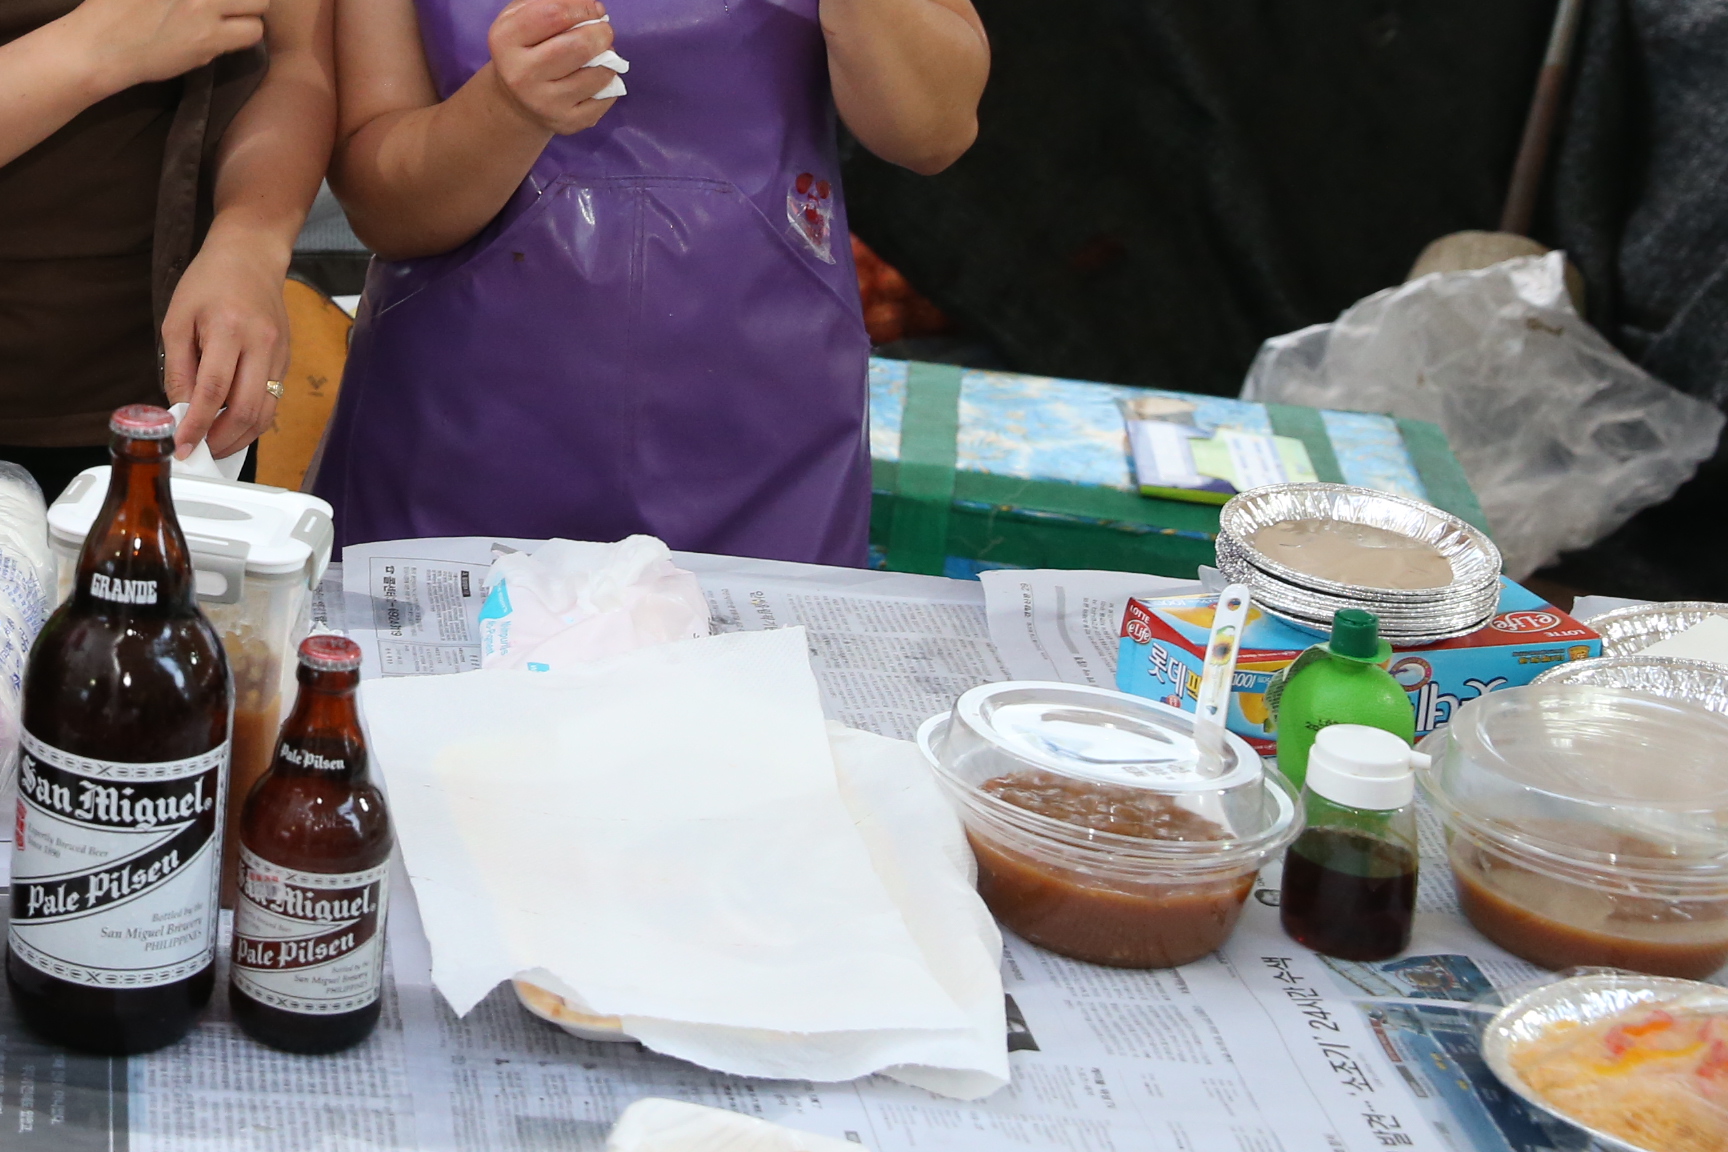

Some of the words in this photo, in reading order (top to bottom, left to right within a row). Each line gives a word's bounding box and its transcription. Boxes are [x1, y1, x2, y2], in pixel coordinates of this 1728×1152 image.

[90, 572, 158, 605] GRANDE
[1129, 604, 1151, 624] LOTTE
[1545, 628, 1586, 638] LOTTE
[280, 743, 302, 765] Pale
[302, 750, 345, 771] Pilsen
[21, 754, 73, 814] San
[74, 776, 206, 830] Miguel
[87, 845, 110, 858] Beer
[28, 884, 80, 917] Pale
[85, 849, 180, 908] Pilsen
[151, 909, 182, 923] Bottled
[183, 907, 192, 921] by
[193, 901, 204, 915] the
[270, 884, 371, 924] Miguel
[100, 926, 123, 939] San
[125, 926, 164, 942] Miguel
[166, 917, 203, 938] Brewery
[144, 930, 203, 952] PHILIPPINES
[237, 938, 274, 967] Pale
[277, 931, 355, 969] Pilsen
[293, 974, 309, 984] San
[311, 975, 340, 987] Miguel
[1260, 956, 1305, 984] 수색
[1282, 986, 1341, 1033] 24시간
